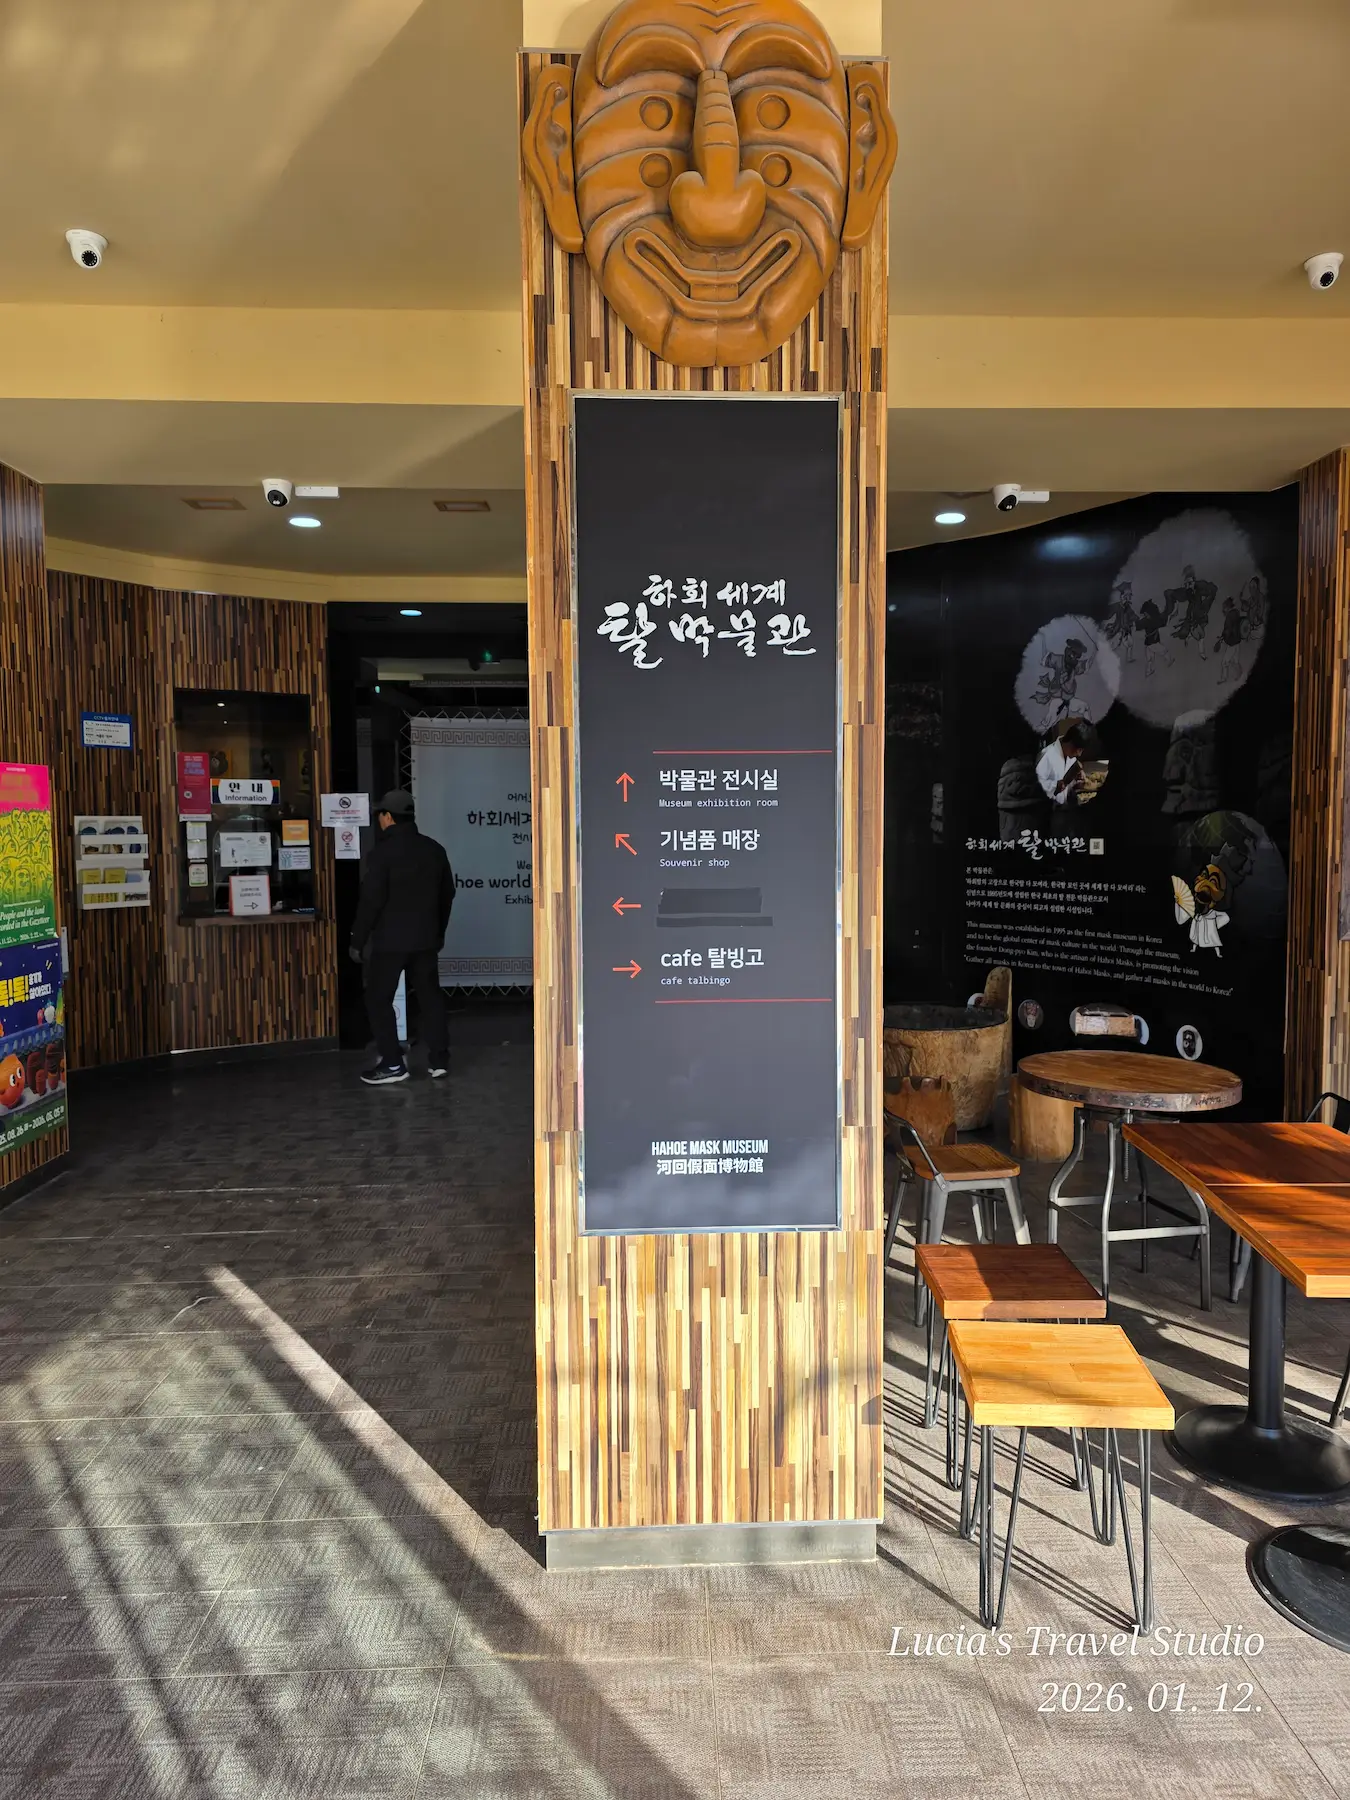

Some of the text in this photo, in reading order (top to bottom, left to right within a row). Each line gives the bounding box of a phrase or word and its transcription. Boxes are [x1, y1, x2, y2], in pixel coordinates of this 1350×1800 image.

[659, 769, 779, 791] 박물관 전시실
[224, 794, 268, 802] Information
[658, 799, 692, 808] Museum
[697, 798, 751, 807] exhibition
[660, 829, 760, 851] 기념품 매장
[660, 858, 730, 868] Souvenir shop
[488, 873, 531, 888] world
[1015, 924, 1045, 933] established
[1113, 933, 1137, 941] museum
[1146, 935, 1163, 944] Korea
[1003, 935, 1020, 943] global
[1062, 940, 1081, 949] culture
[1089, 942, 1098, 950] the
[1119, 945, 1143, 956] Through
[1144, 948, 1154, 956] the
[660, 948, 764, 968] cafe 탈빙고
[976, 944, 998, 952] founder
[1142, 962, 1171, 973] promoting
[1172, 965, 1182, 973] the
[1183, 967, 1199, 976] vision
[660, 976, 730, 986] cafe talbingo
[1018, 960, 1034, 969] Korea
[1042, 962, 1051, 970] the
[1178, 980, 1188, 988] the
[1188, 983, 1205, 992] world
[651, 1140, 768, 1156] HAHOE MASK MUSEUM
[656, 1157, 764, 1175] 河回假面博物館
